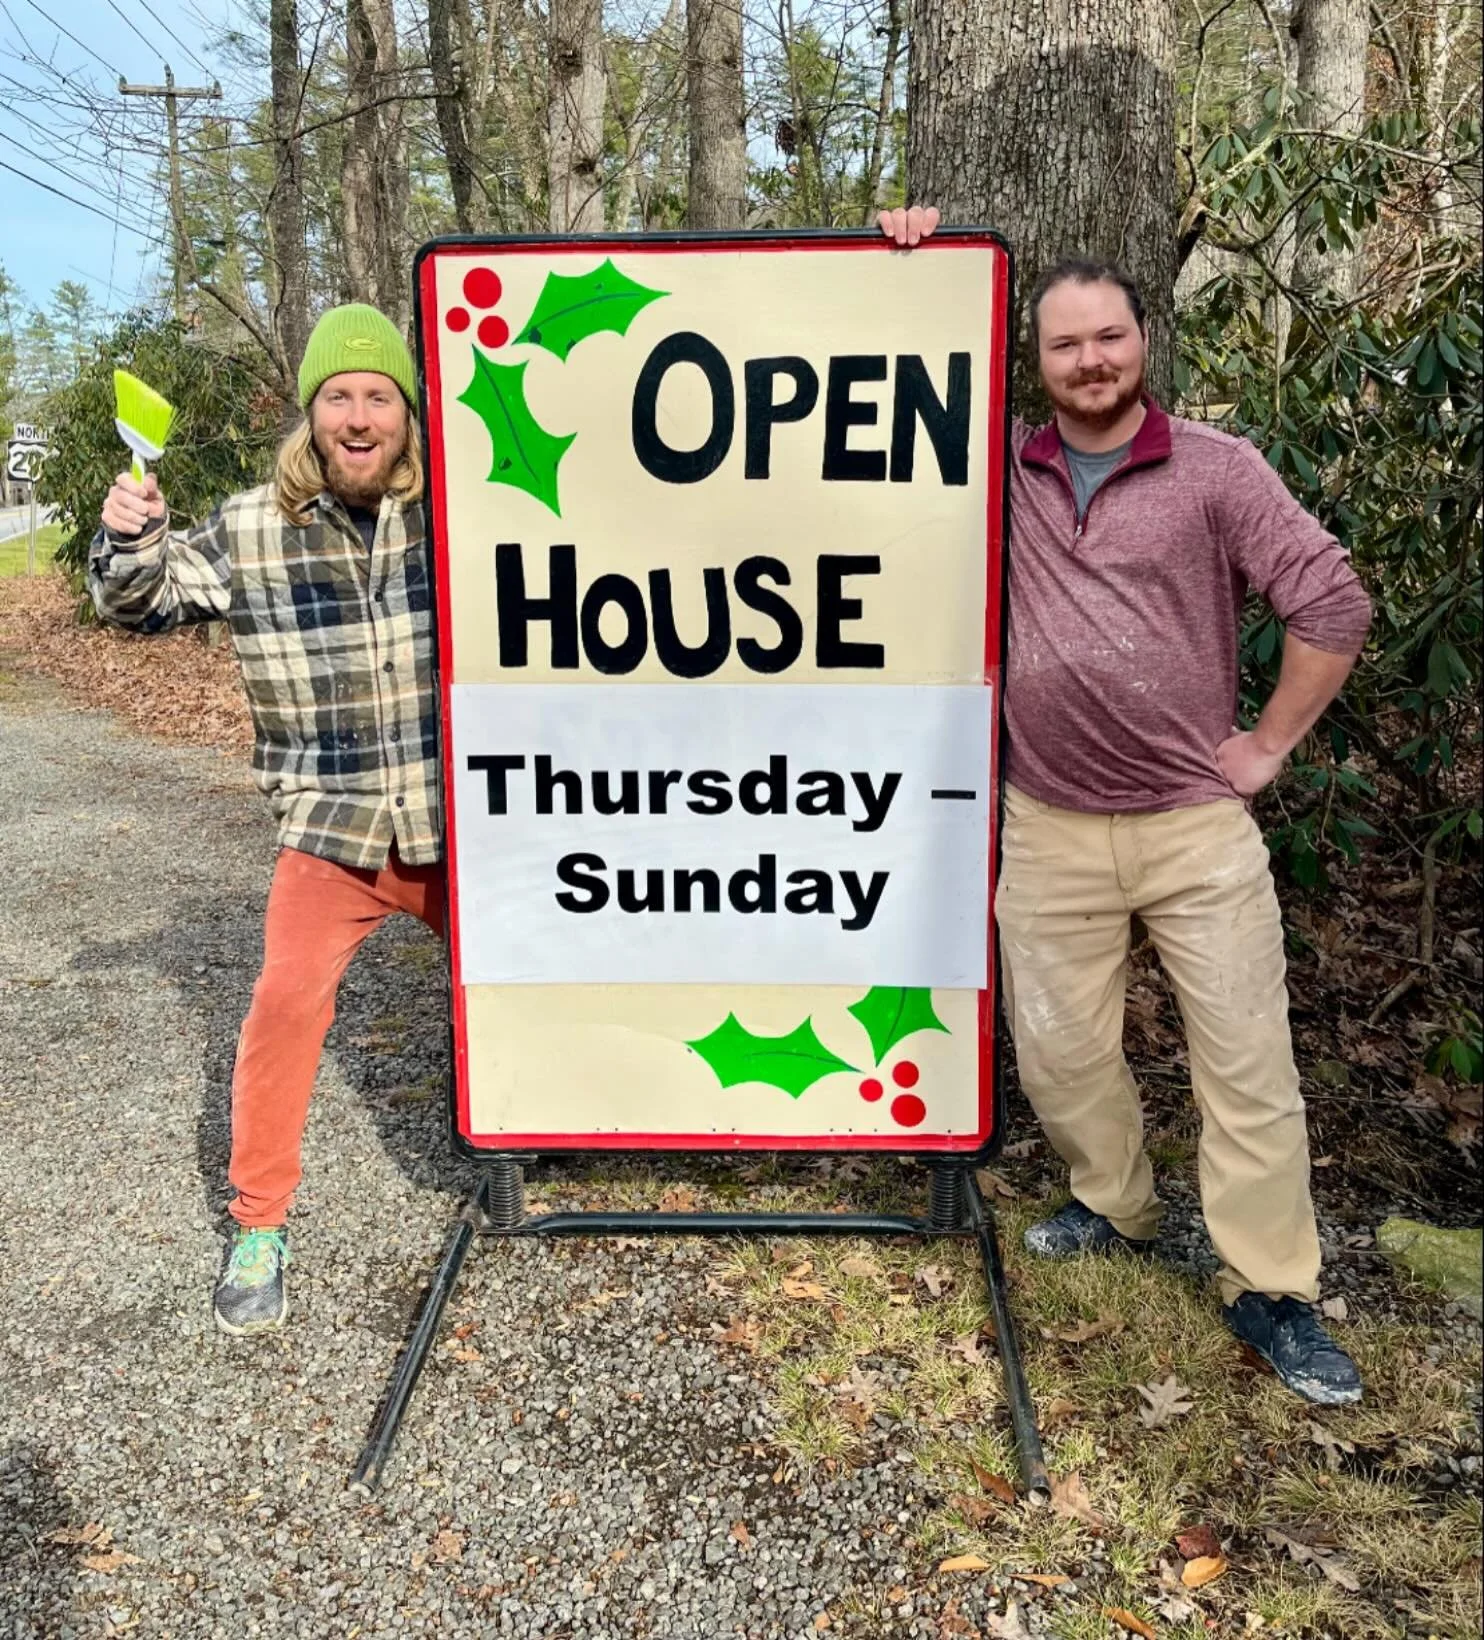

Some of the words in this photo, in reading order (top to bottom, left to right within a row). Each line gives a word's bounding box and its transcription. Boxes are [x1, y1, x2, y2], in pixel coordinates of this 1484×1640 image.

[631, 331, 971, 486] OPEN
[495, 543, 885, 679] HOUSE
[467, 754, 903, 833] Thursday
[555, 852, 890, 931] Sunday
